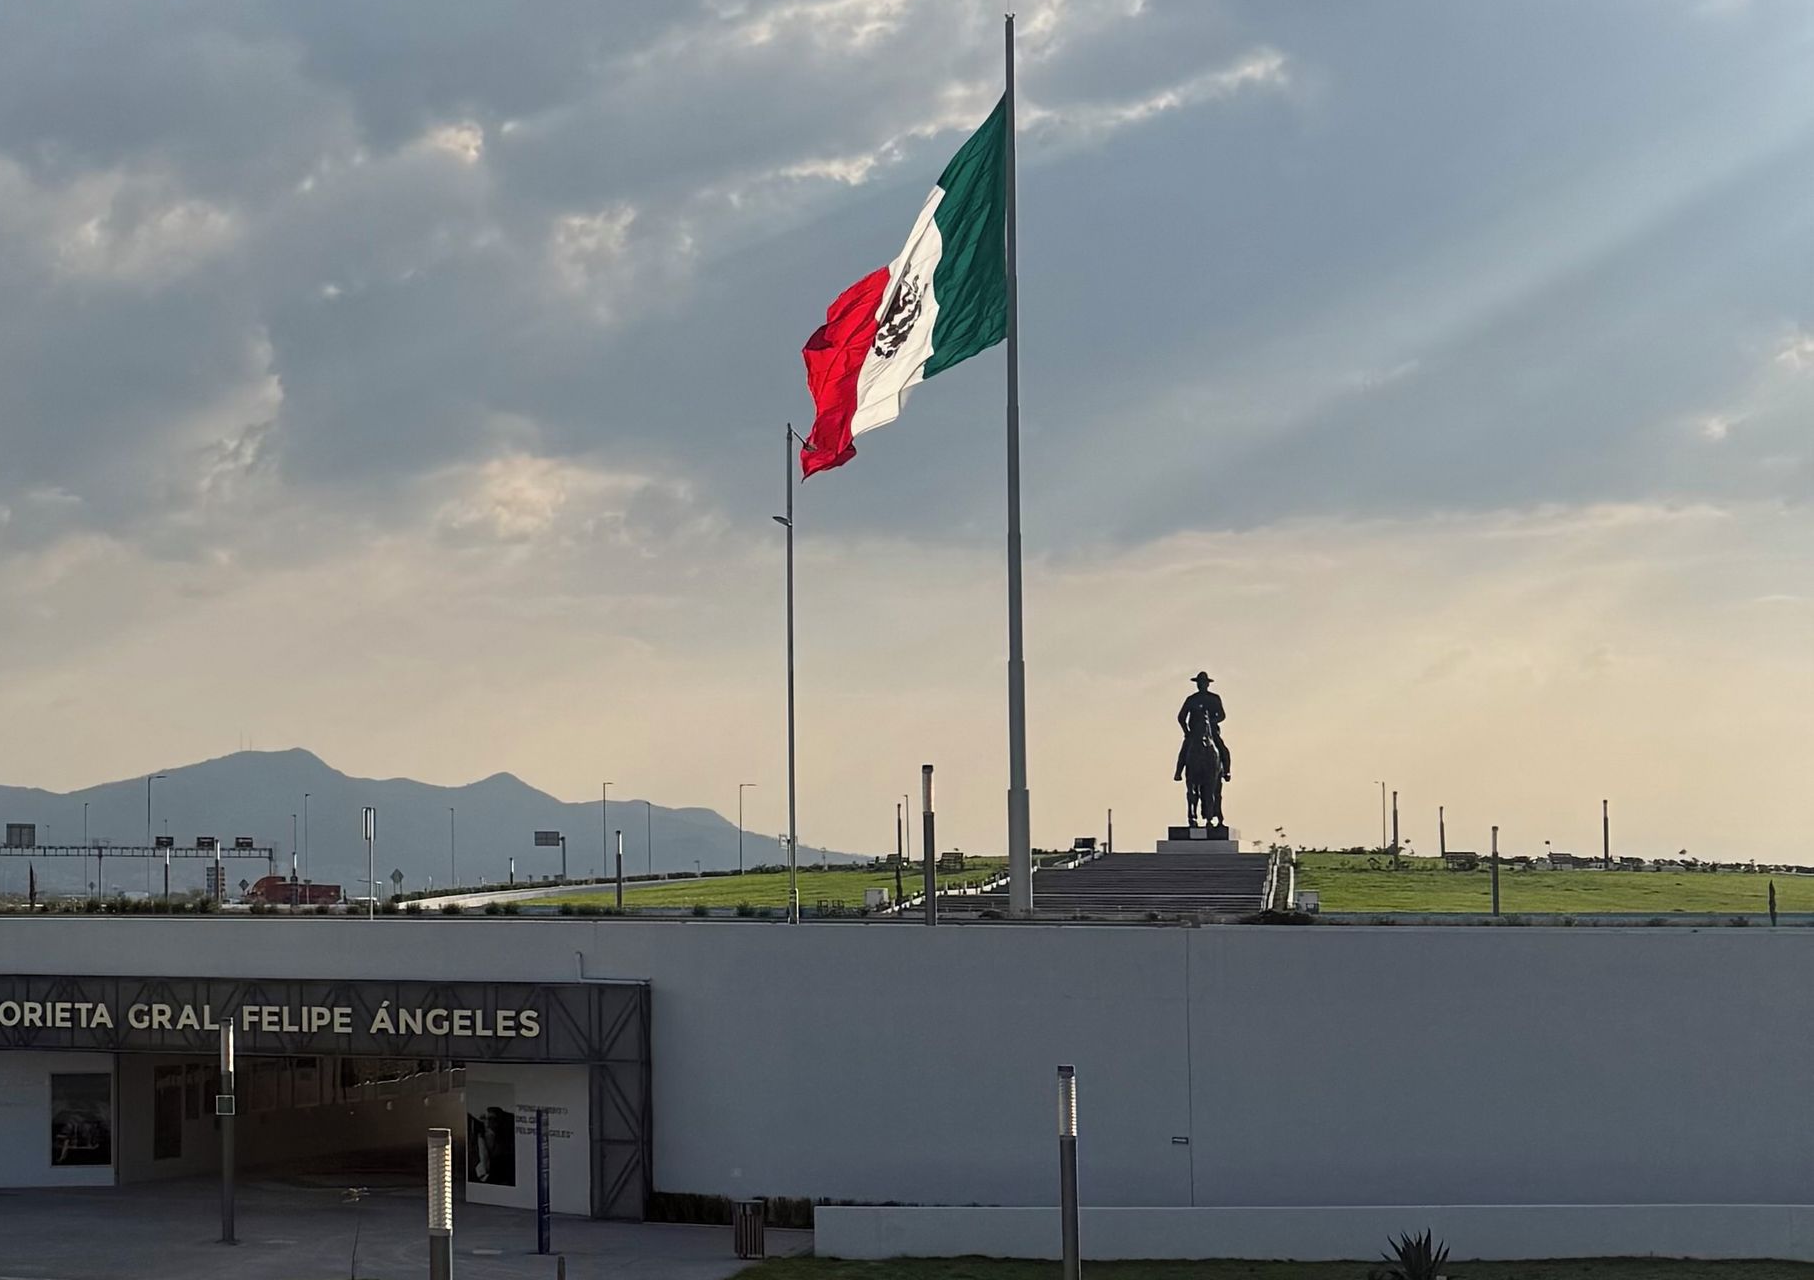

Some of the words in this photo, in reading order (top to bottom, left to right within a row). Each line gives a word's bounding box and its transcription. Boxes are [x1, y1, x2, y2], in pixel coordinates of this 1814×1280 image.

[128, 1003, 221, 1031] GRAL
[242, 1005, 353, 1034] FELIPE
[369, 1000, 540, 1038] ÁNGELES
